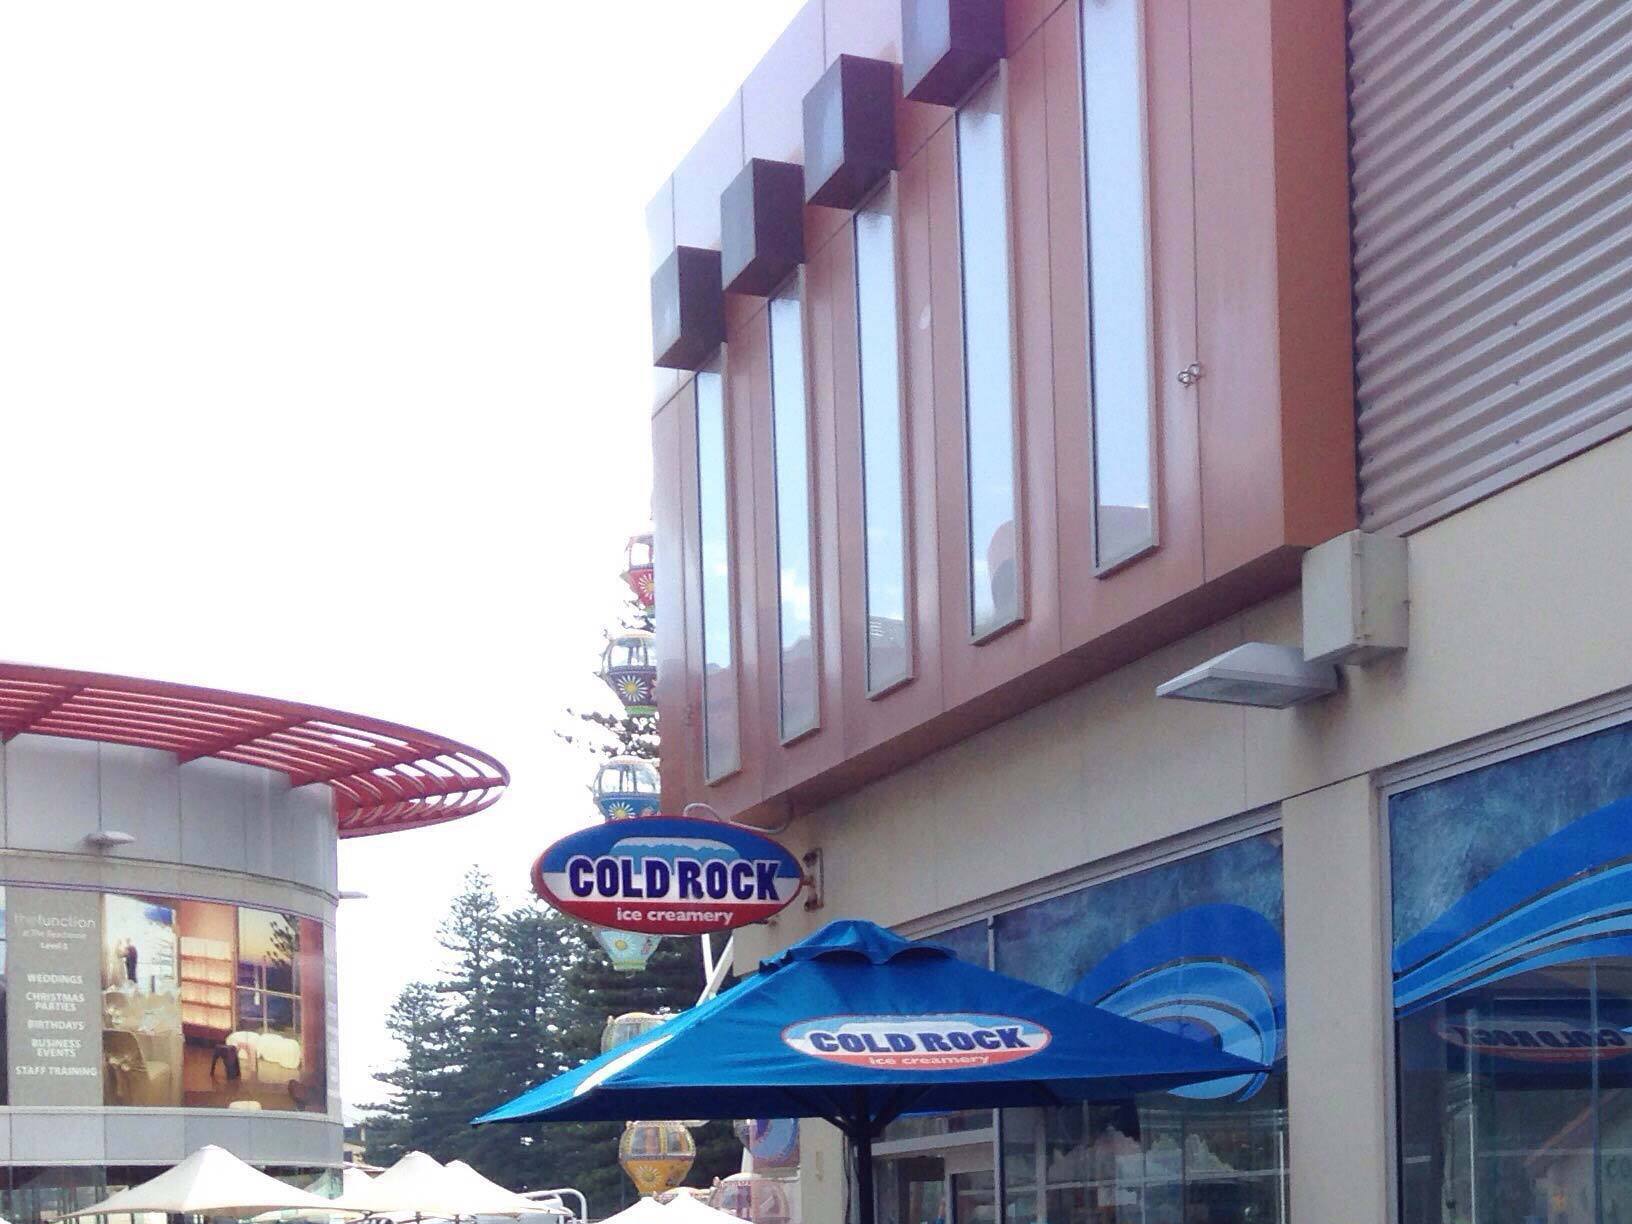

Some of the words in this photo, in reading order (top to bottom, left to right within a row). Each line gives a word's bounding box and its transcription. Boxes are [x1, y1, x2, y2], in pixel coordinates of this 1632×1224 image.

[567, 857, 670, 899] COLD
[677, 859, 780, 901] ROCK
[616, 906, 642, 922] ice
[646, 908, 734, 925] creamery
[27, 973, 84, 985] WEDDINGS
[25, 991, 86, 1003] CHRISTMAS
[34, 1002, 77, 1012] PARTIES
[27, 1019, 86, 1031] BIRTHDAYS
[31, 1038, 82, 1048] BUSINESS
[808, 1031, 916, 1053] COLD
[918, 1027, 1031, 1053] ROCK
[37, 1048, 76, 1057] EVENTS
[869, 1055, 897, 1066] ice
[901, 1055, 990, 1066] creamery
[15, 1065, 46, 1076] STAFF
[48, 1066, 98, 1077] TRAINING
